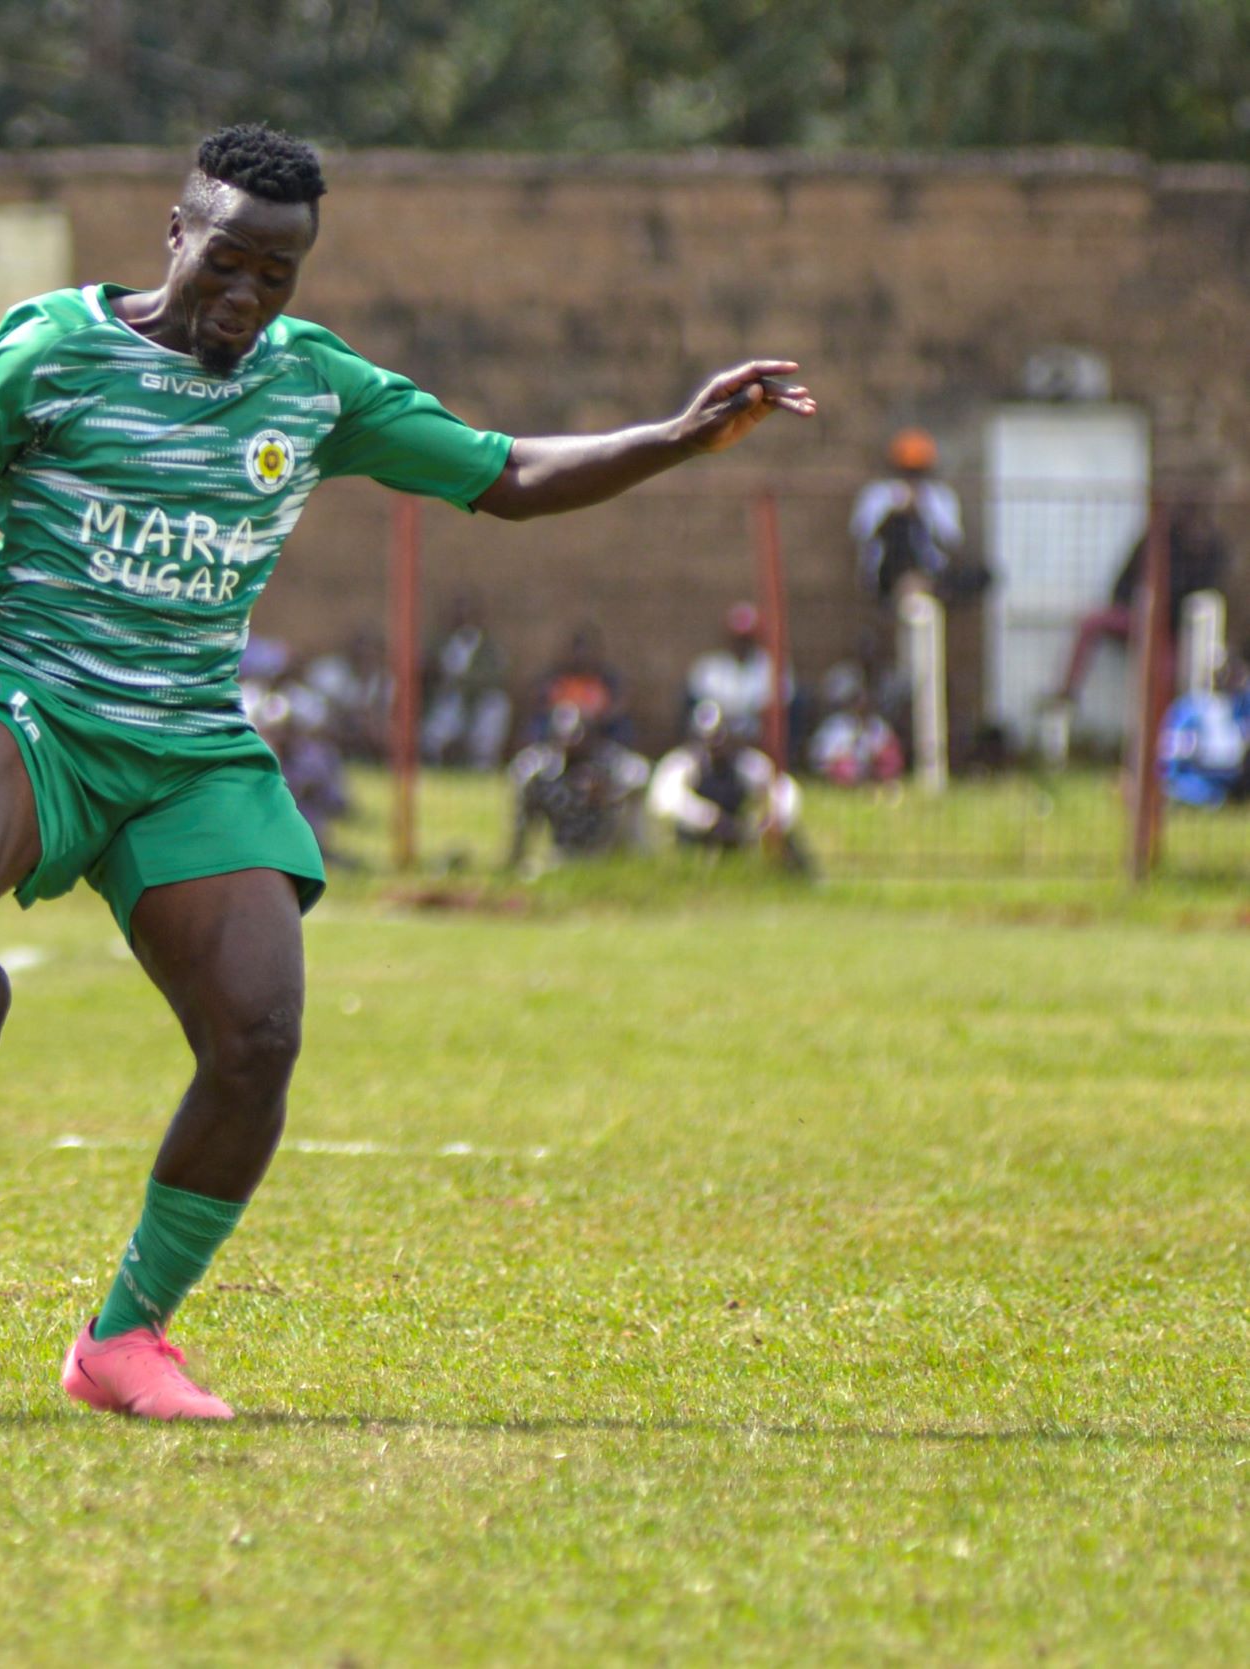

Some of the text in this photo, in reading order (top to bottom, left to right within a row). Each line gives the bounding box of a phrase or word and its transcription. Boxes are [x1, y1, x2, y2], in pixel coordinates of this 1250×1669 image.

[141, 372, 243, 400] GIVOVA
[80, 499, 255, 566] MARA
[88, 550, 241, 602] SUGAR
